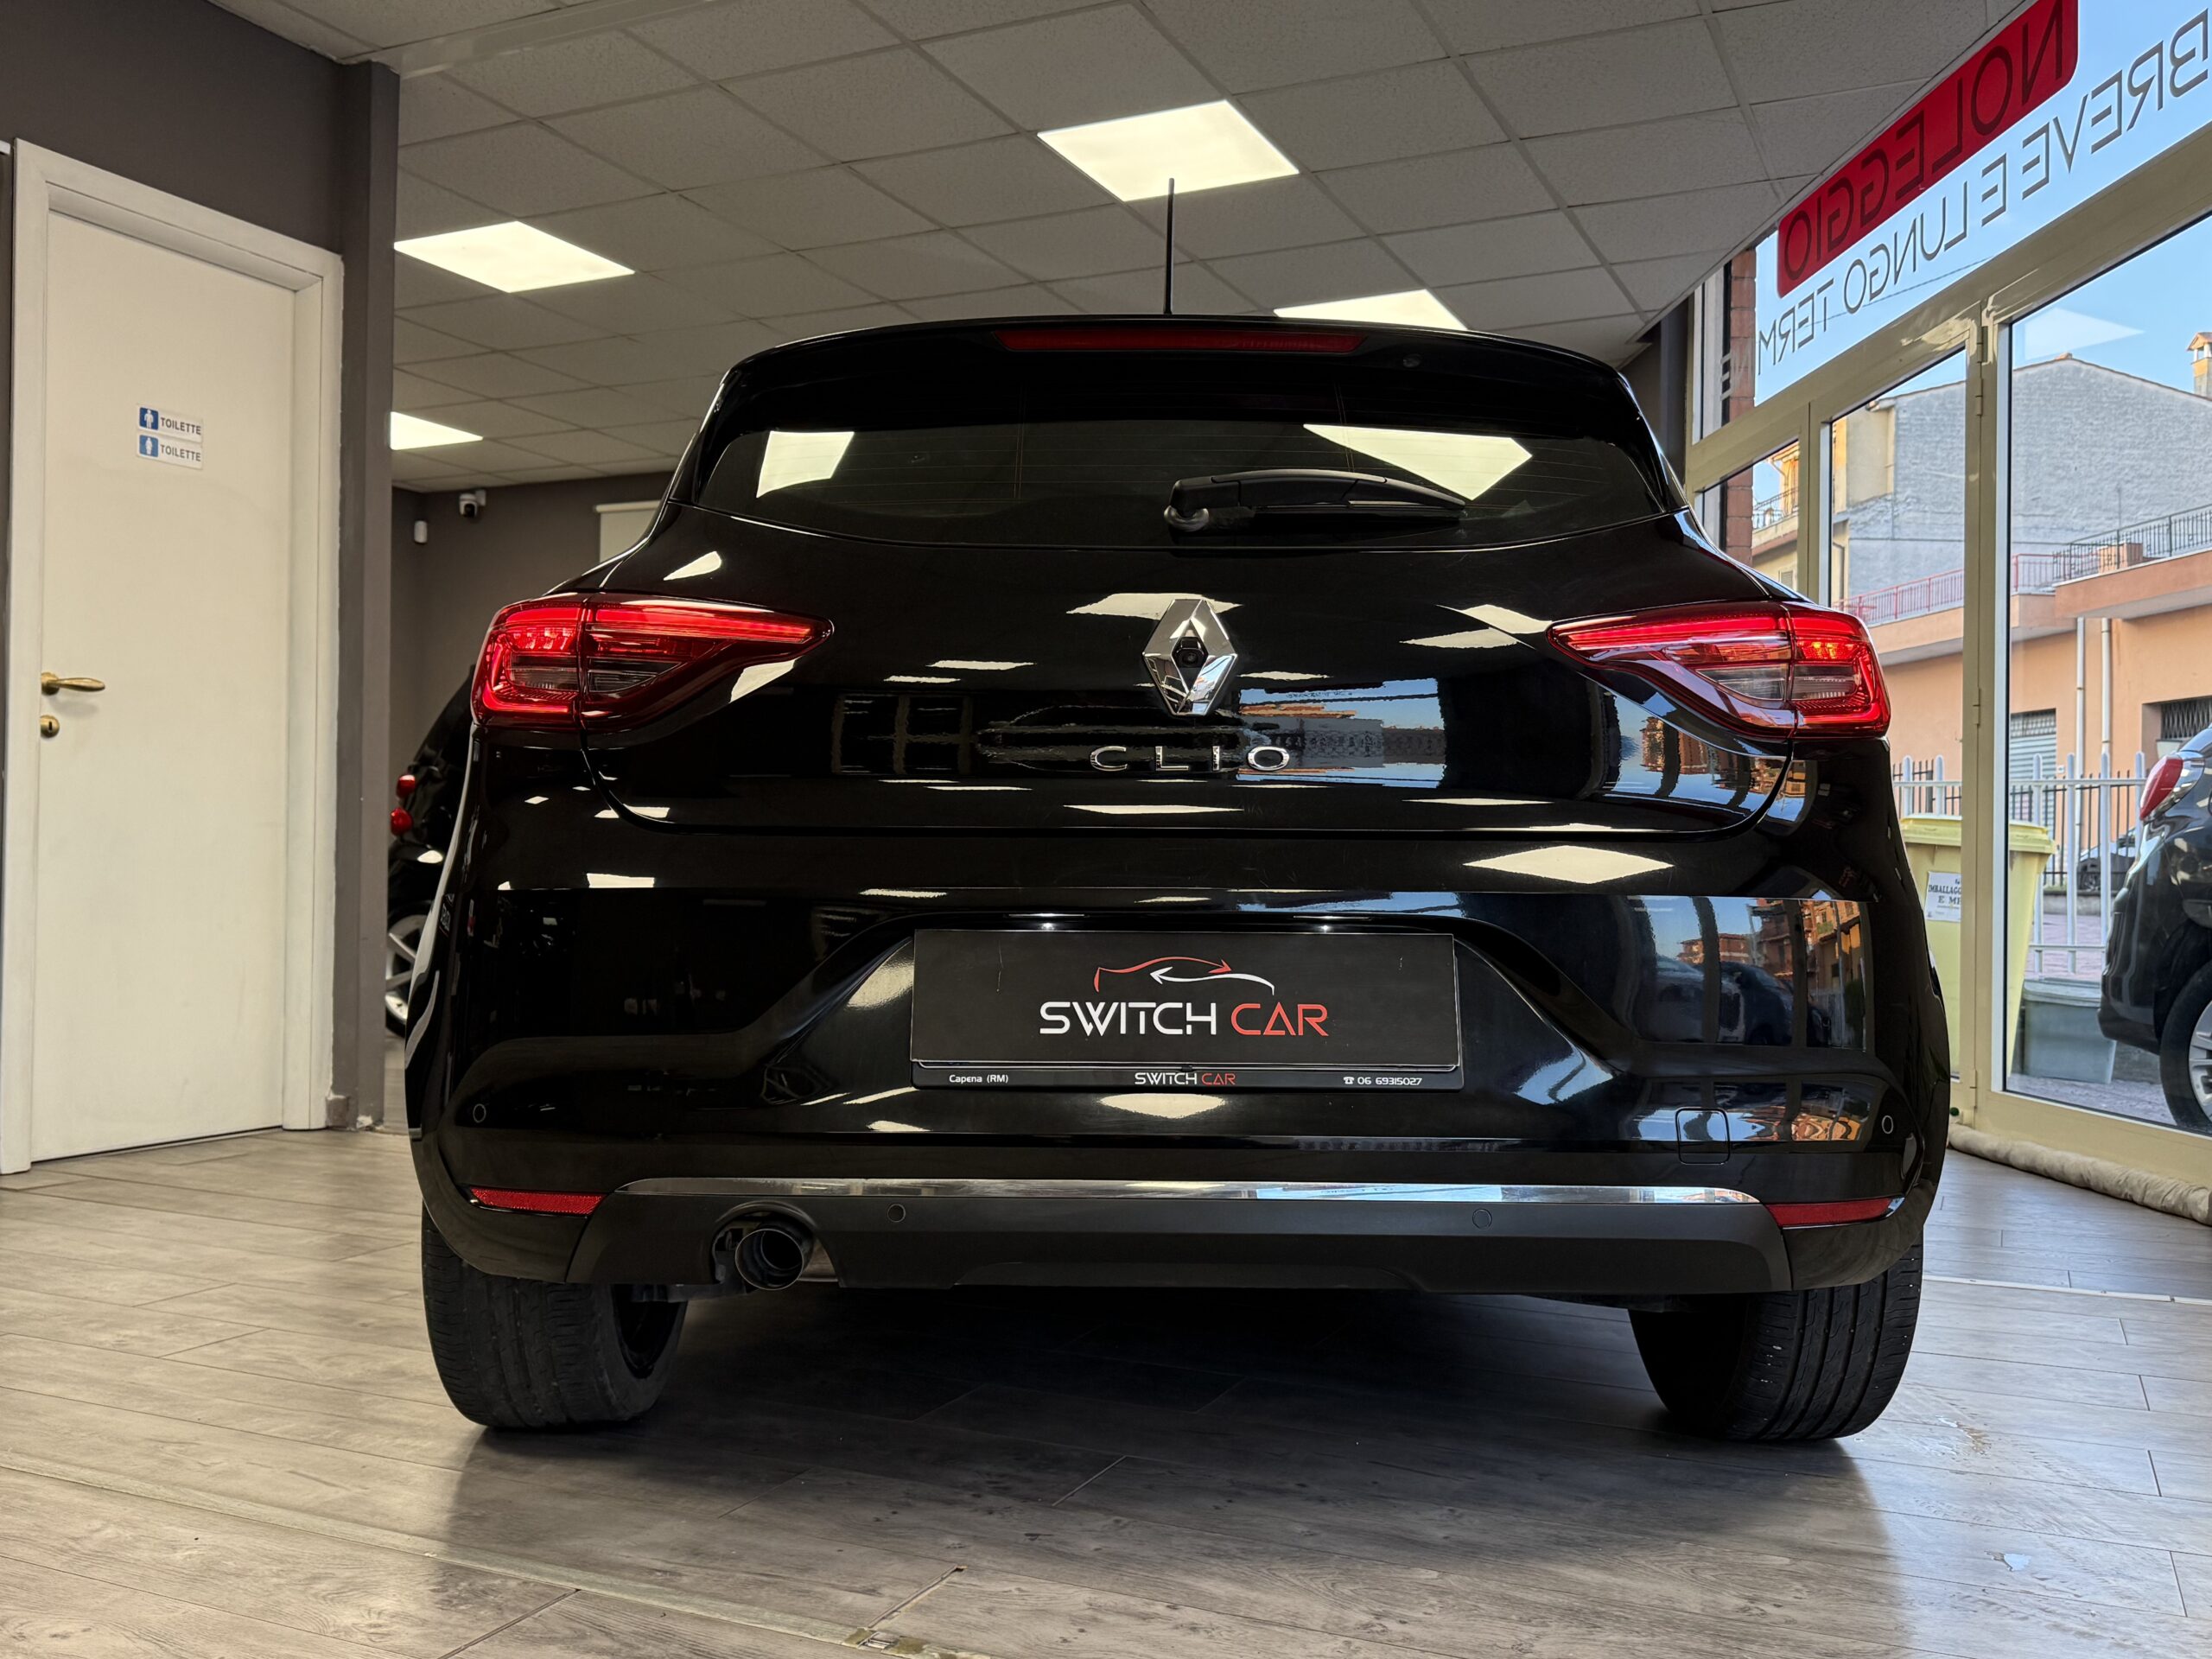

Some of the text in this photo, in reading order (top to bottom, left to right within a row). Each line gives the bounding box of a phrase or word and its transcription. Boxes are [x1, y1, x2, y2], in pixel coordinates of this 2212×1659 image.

[160, 416, 201, 435] TOILETTE
[160, 443, 201, 462] TOILETTE
[1090, 745, 1291, 772] CLIO
[1039, 1001, 1330, 1037] SWITCH CAR
[949, 1074, 1009, 1084] Capena (RM)
[1135, 1072, 1236, 1085] SWITCH CAR
[1357, 1076, 1423, 1086] 06 69315027
